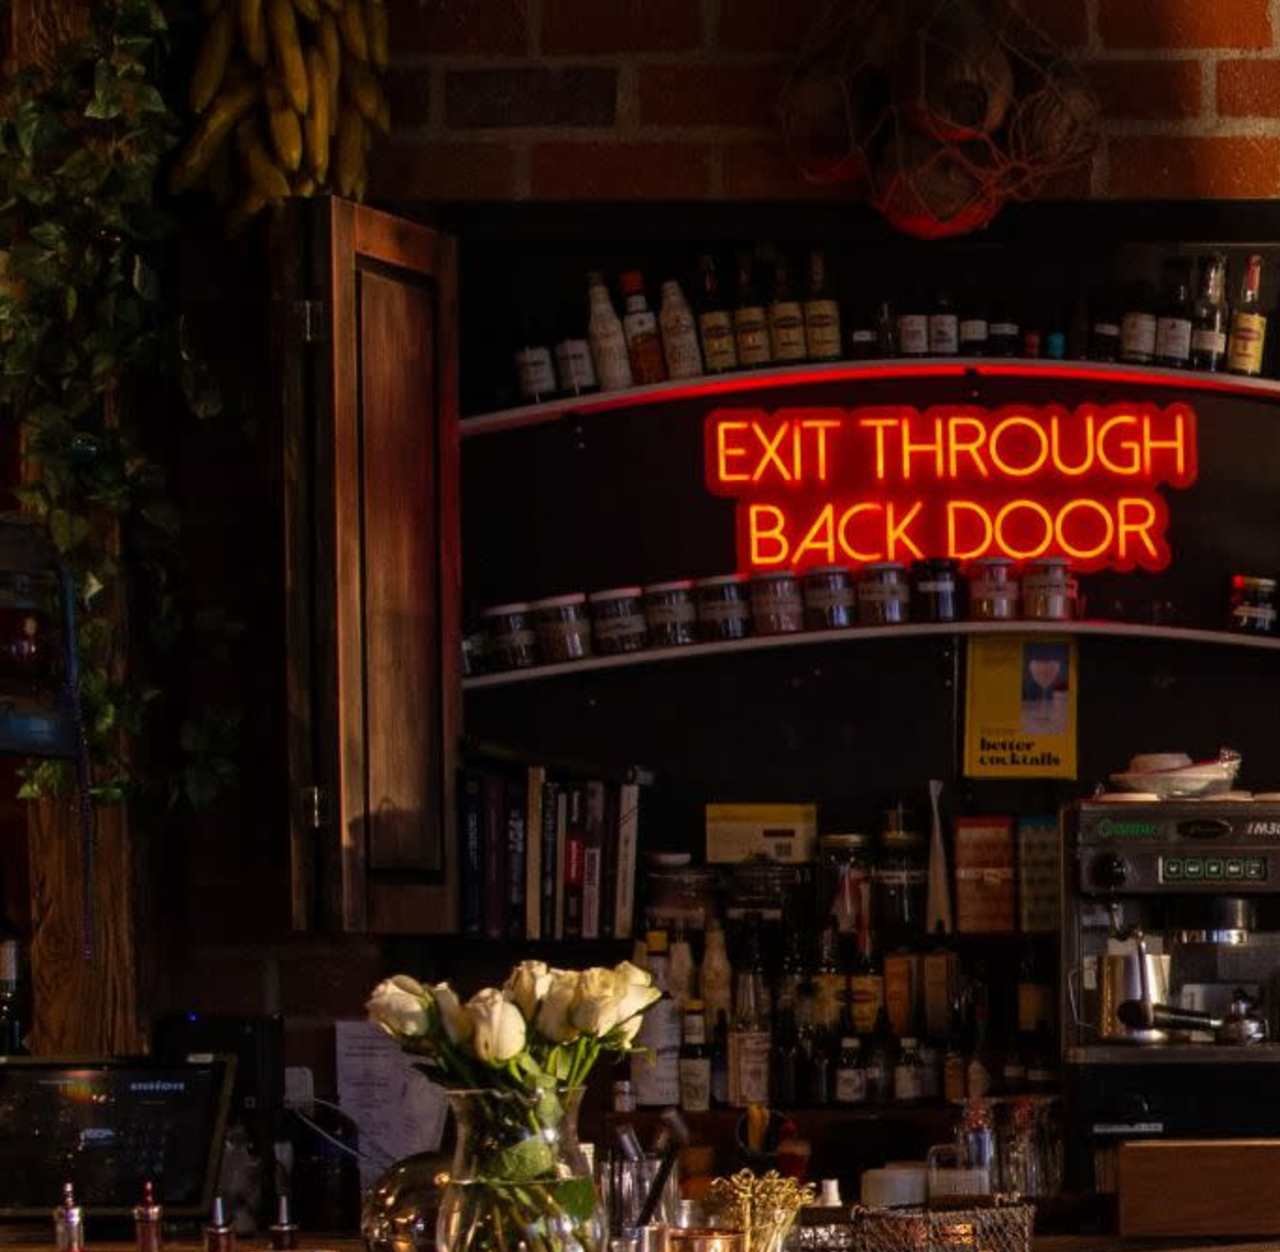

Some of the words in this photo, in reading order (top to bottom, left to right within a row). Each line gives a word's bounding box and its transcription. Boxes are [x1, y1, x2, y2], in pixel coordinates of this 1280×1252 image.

[716, 419, 842, 482] EXIT
[858, 414, 1185, 479] THROUGH
[747, 501, 926, 566] BACK
[946, 496, 1160, 560] DOOR
[979, 736, 1036, 752] better
[979, 751, 1061, 766] cocktails
